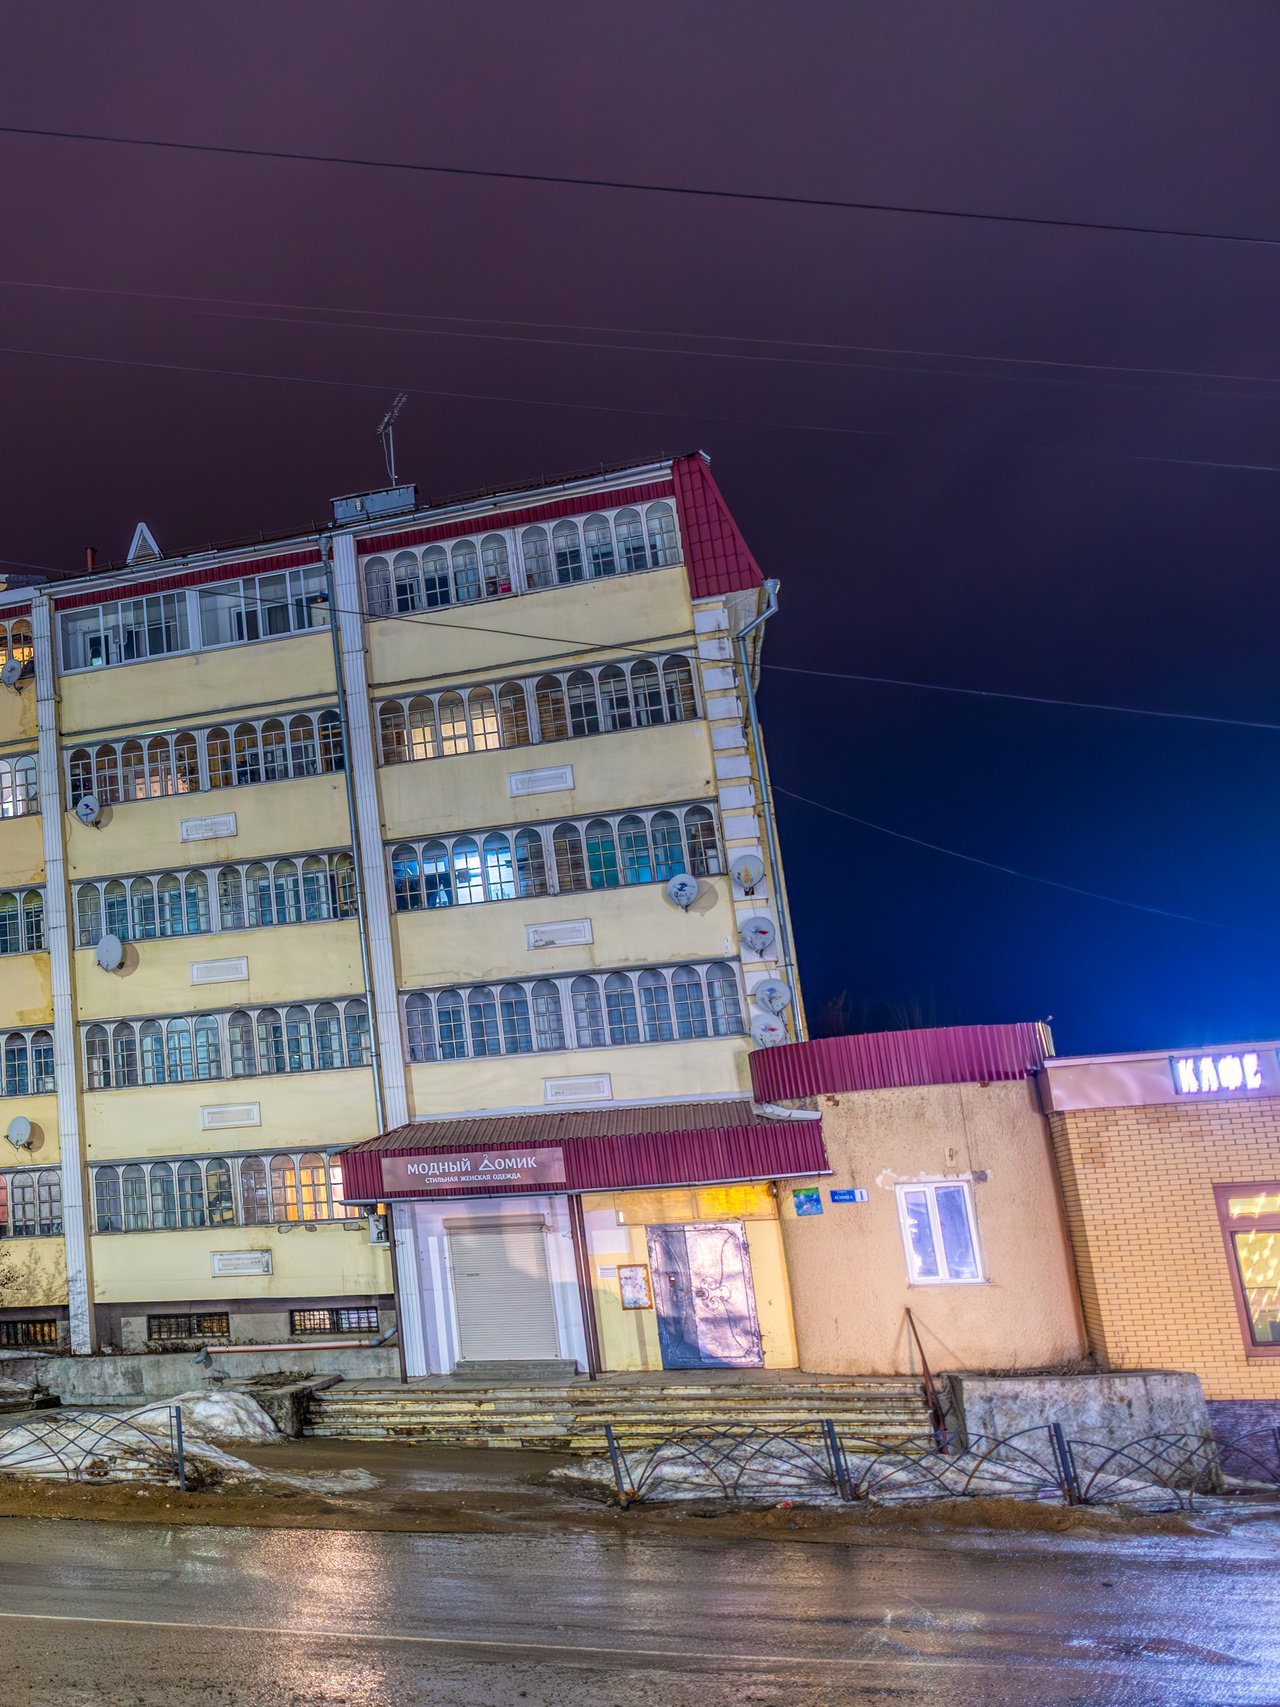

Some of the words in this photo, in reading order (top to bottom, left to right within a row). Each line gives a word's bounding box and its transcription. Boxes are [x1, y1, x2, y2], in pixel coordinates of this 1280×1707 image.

[1178, 1051, 1262, 1094] КАФЕ
[407, 1157, 471, 1176] МОДНЫЙ
[424, 1175, 459, 1184] СТИЛЬНАЯ
[460, 1173, 491, 1182] ЖЕНСКАЯ
[492, 1172, 522, 1181] ОДЕЖДА
